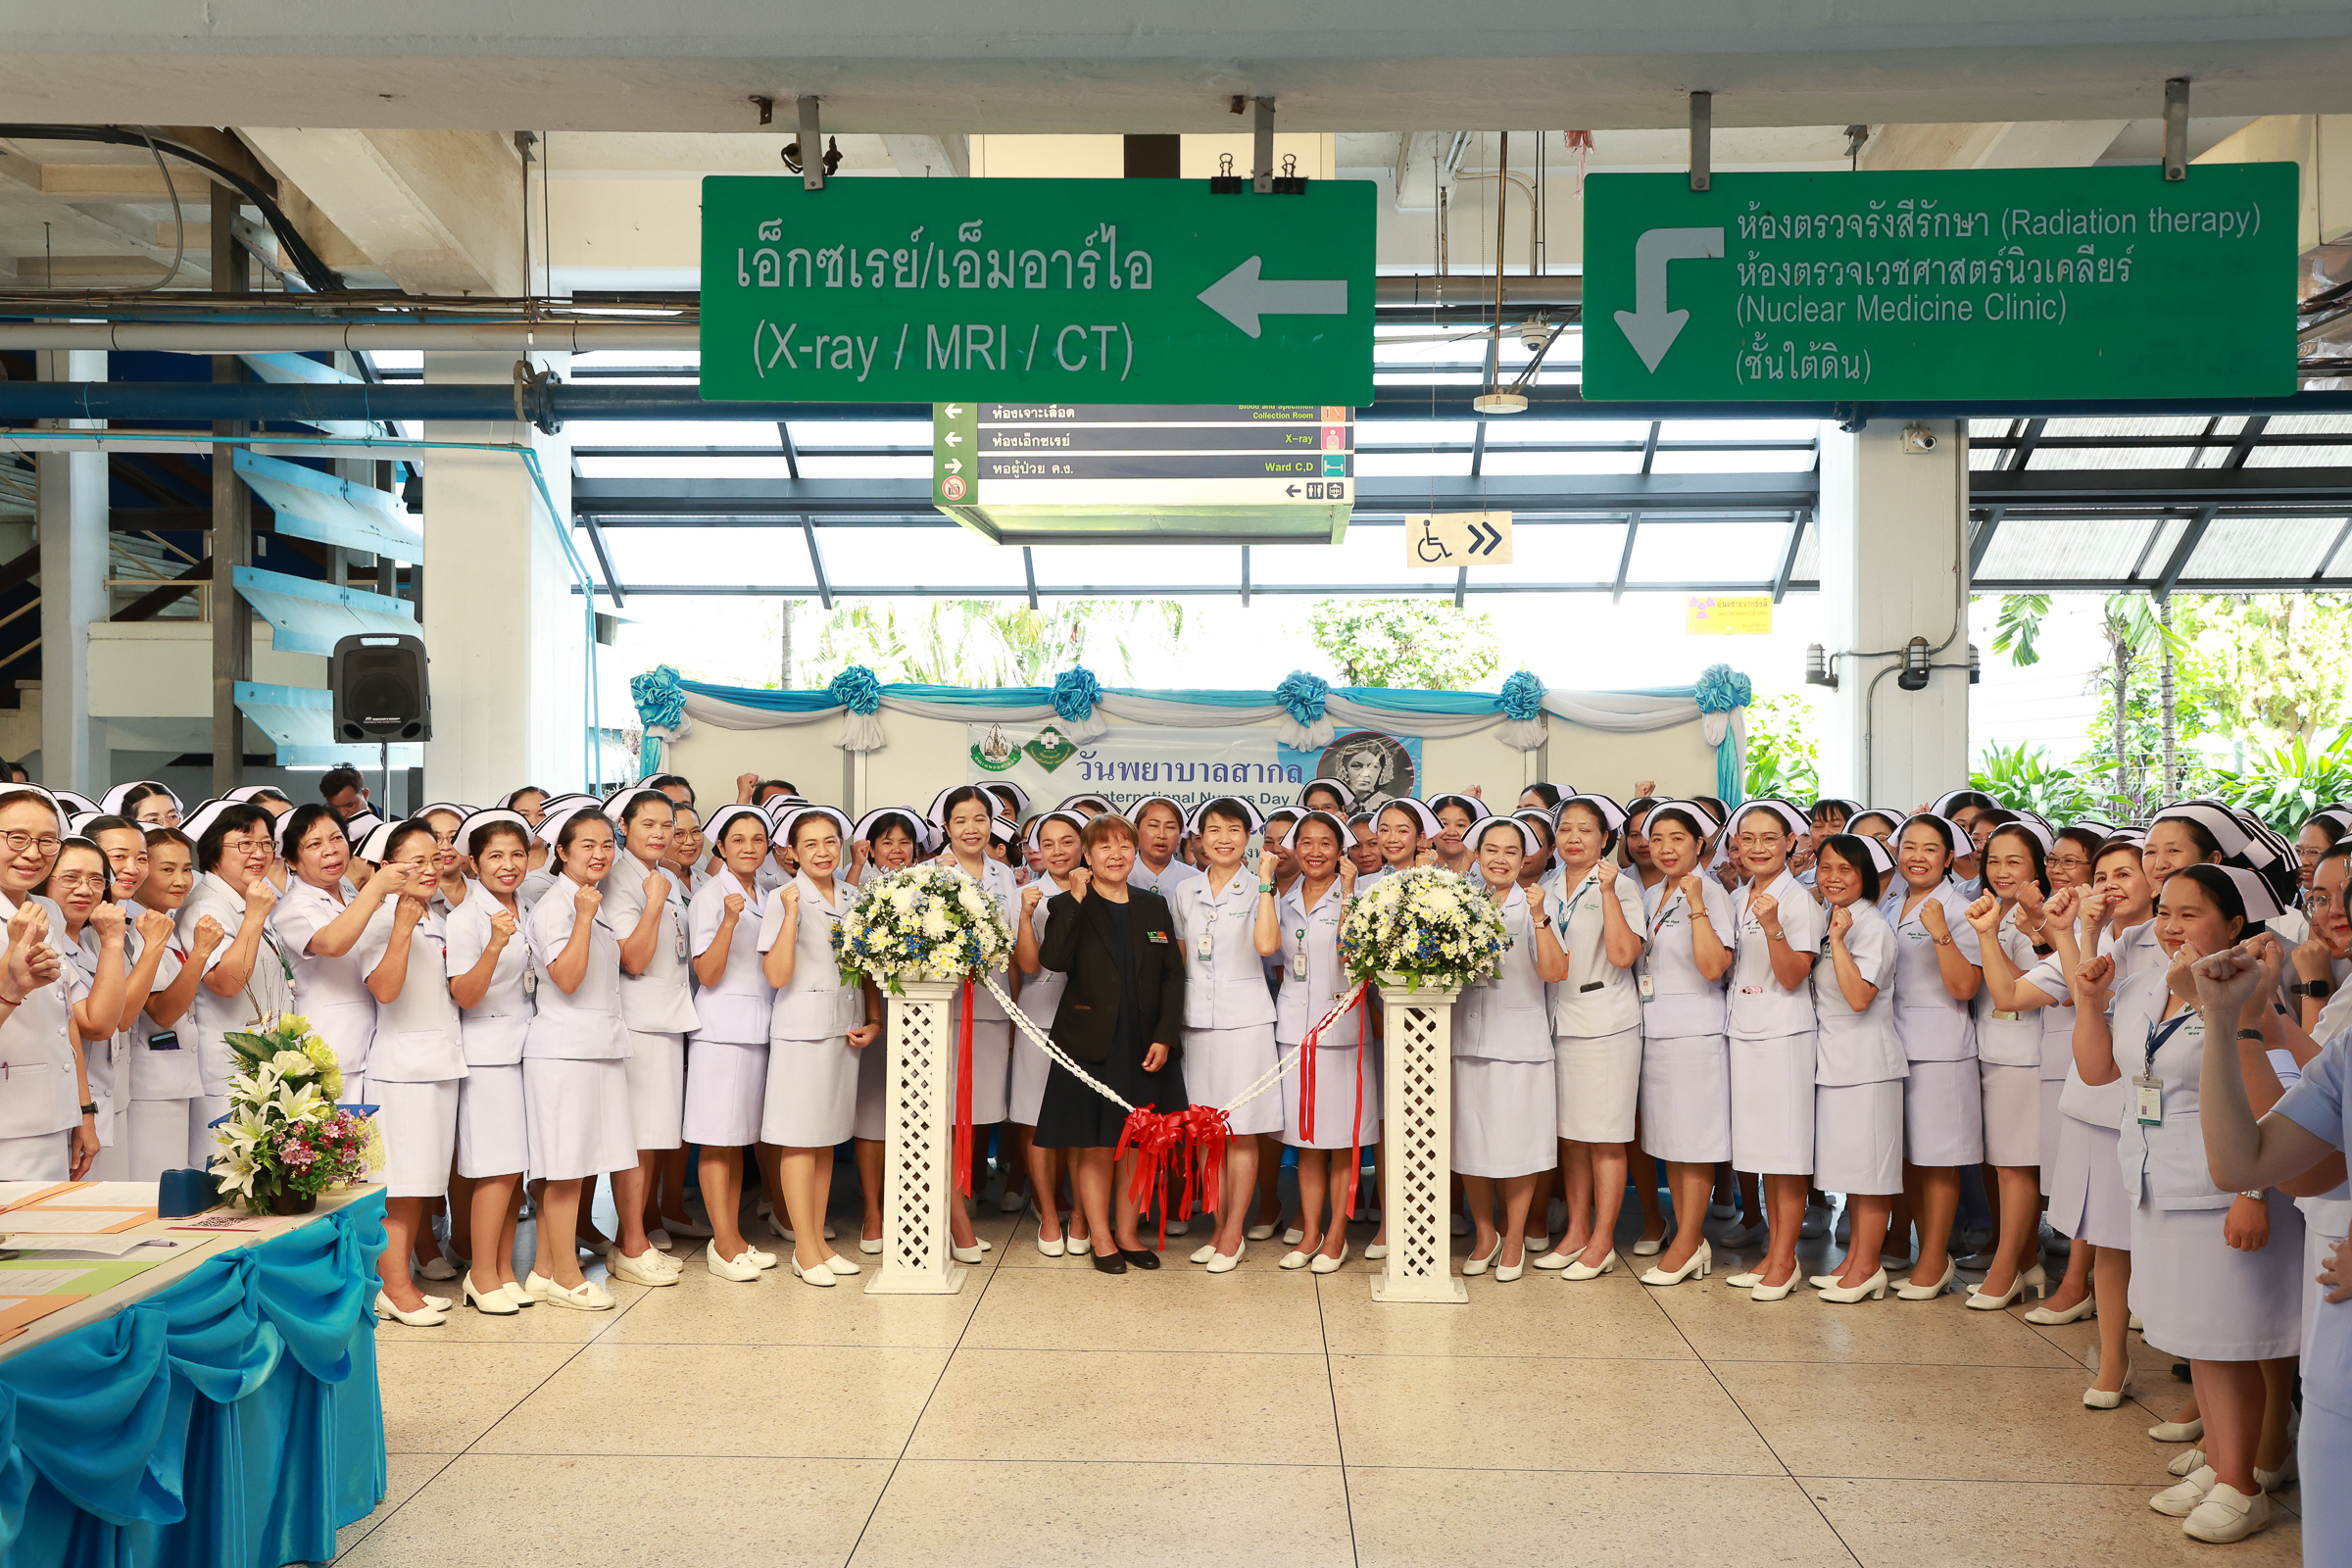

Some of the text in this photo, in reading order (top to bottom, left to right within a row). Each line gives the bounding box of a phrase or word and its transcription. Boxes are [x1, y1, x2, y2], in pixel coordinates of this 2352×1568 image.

[1738, 199, 2261, 241] ห้องตรวจรังสีรักษา (Radiation therapy)
[737, 218, 1152, 290] เอ็กซเรย์/เอ็มอาร์ไอ
[1737, 243, 2133, 287] ห้องตรวจเวชศาสตร์นิวเคลียร์
[1737, 291, 2067, 328] (Nuclear Medicine Clinic)
[754, 319, 1133, 382] (X-ray / MRI / CT)
[1736, 331, 1872, 385] (ชั้นใต้ดิน)
[992, 404, 1075, 419] ห้องเจาะเลือด
[992, 431, 1071, 447] ห้องเอ็กซเรย์
[1285, 434, 1314, 445] X-ray
[992, 460, 1074, 478] หอผู้ป่วย ค.ง.
[1264, 463, 1314, 473] Ward C,D
[1076, 751, 1302, 783] วันพยาบาลสากล
[1260, 792, 1290, 807] Day
